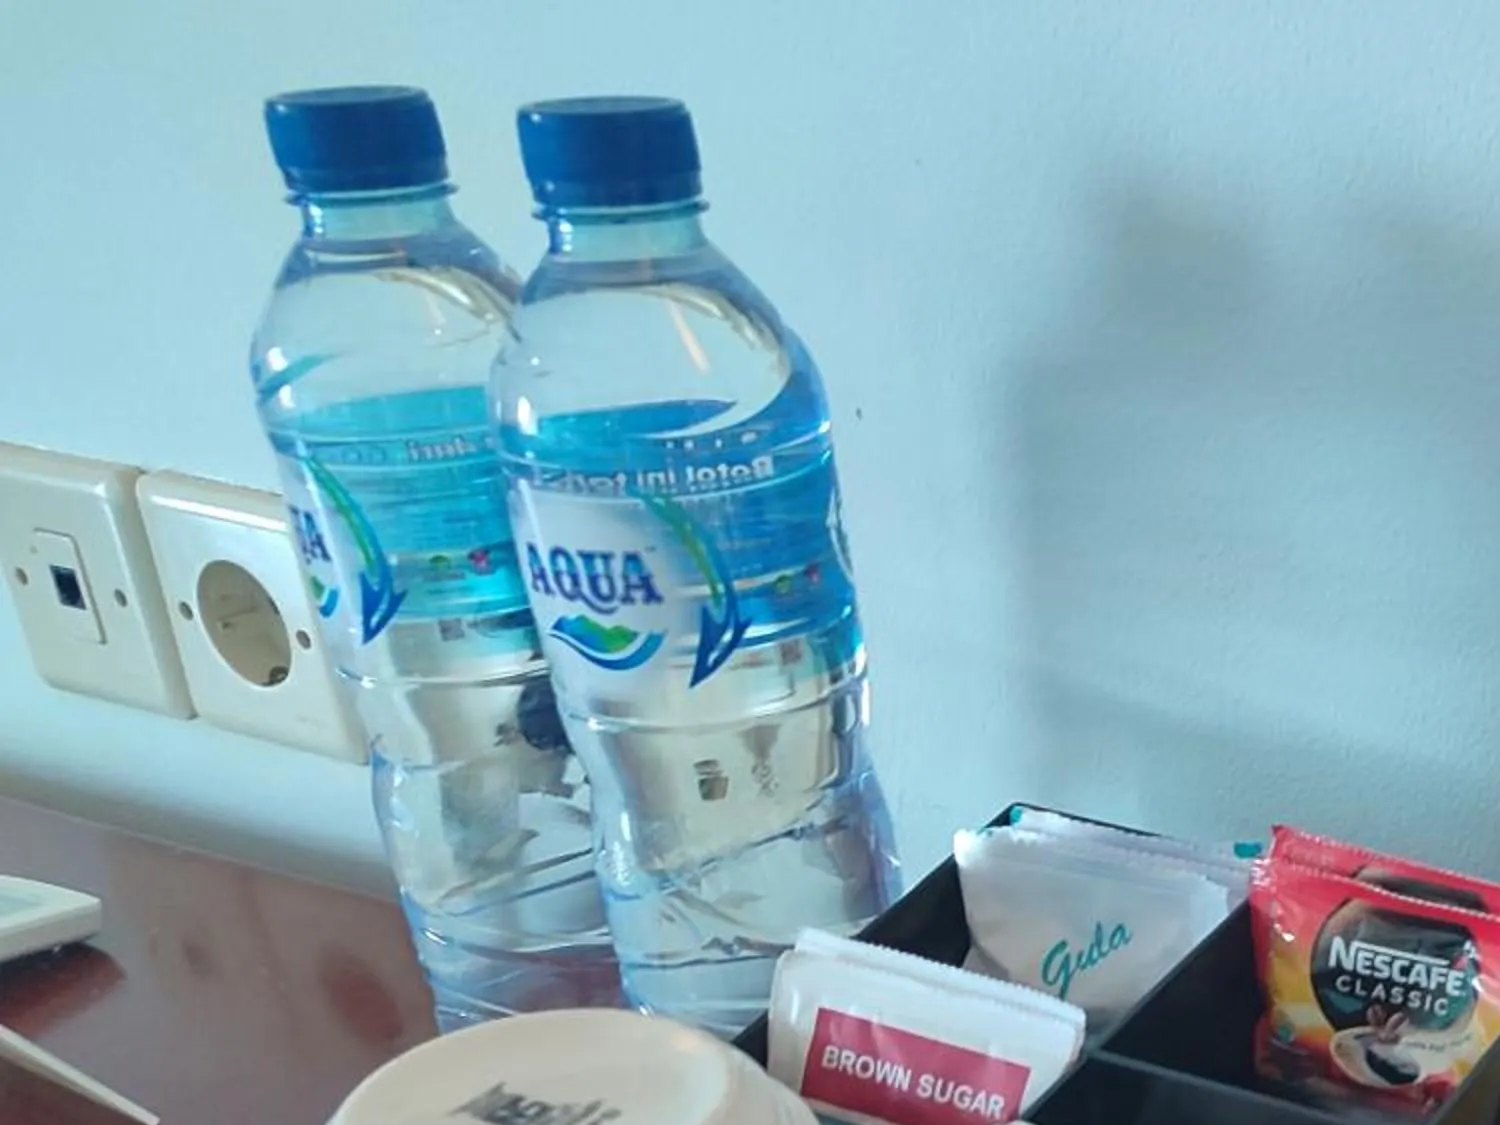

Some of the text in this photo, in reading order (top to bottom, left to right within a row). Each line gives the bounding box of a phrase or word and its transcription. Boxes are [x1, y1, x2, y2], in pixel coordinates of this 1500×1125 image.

[523, 542, 666, 614] AQUA
[1335, 975, 1450, 1017] CLASSIC
[821, 1045, 1005, 1120] BROWN SUGAR
